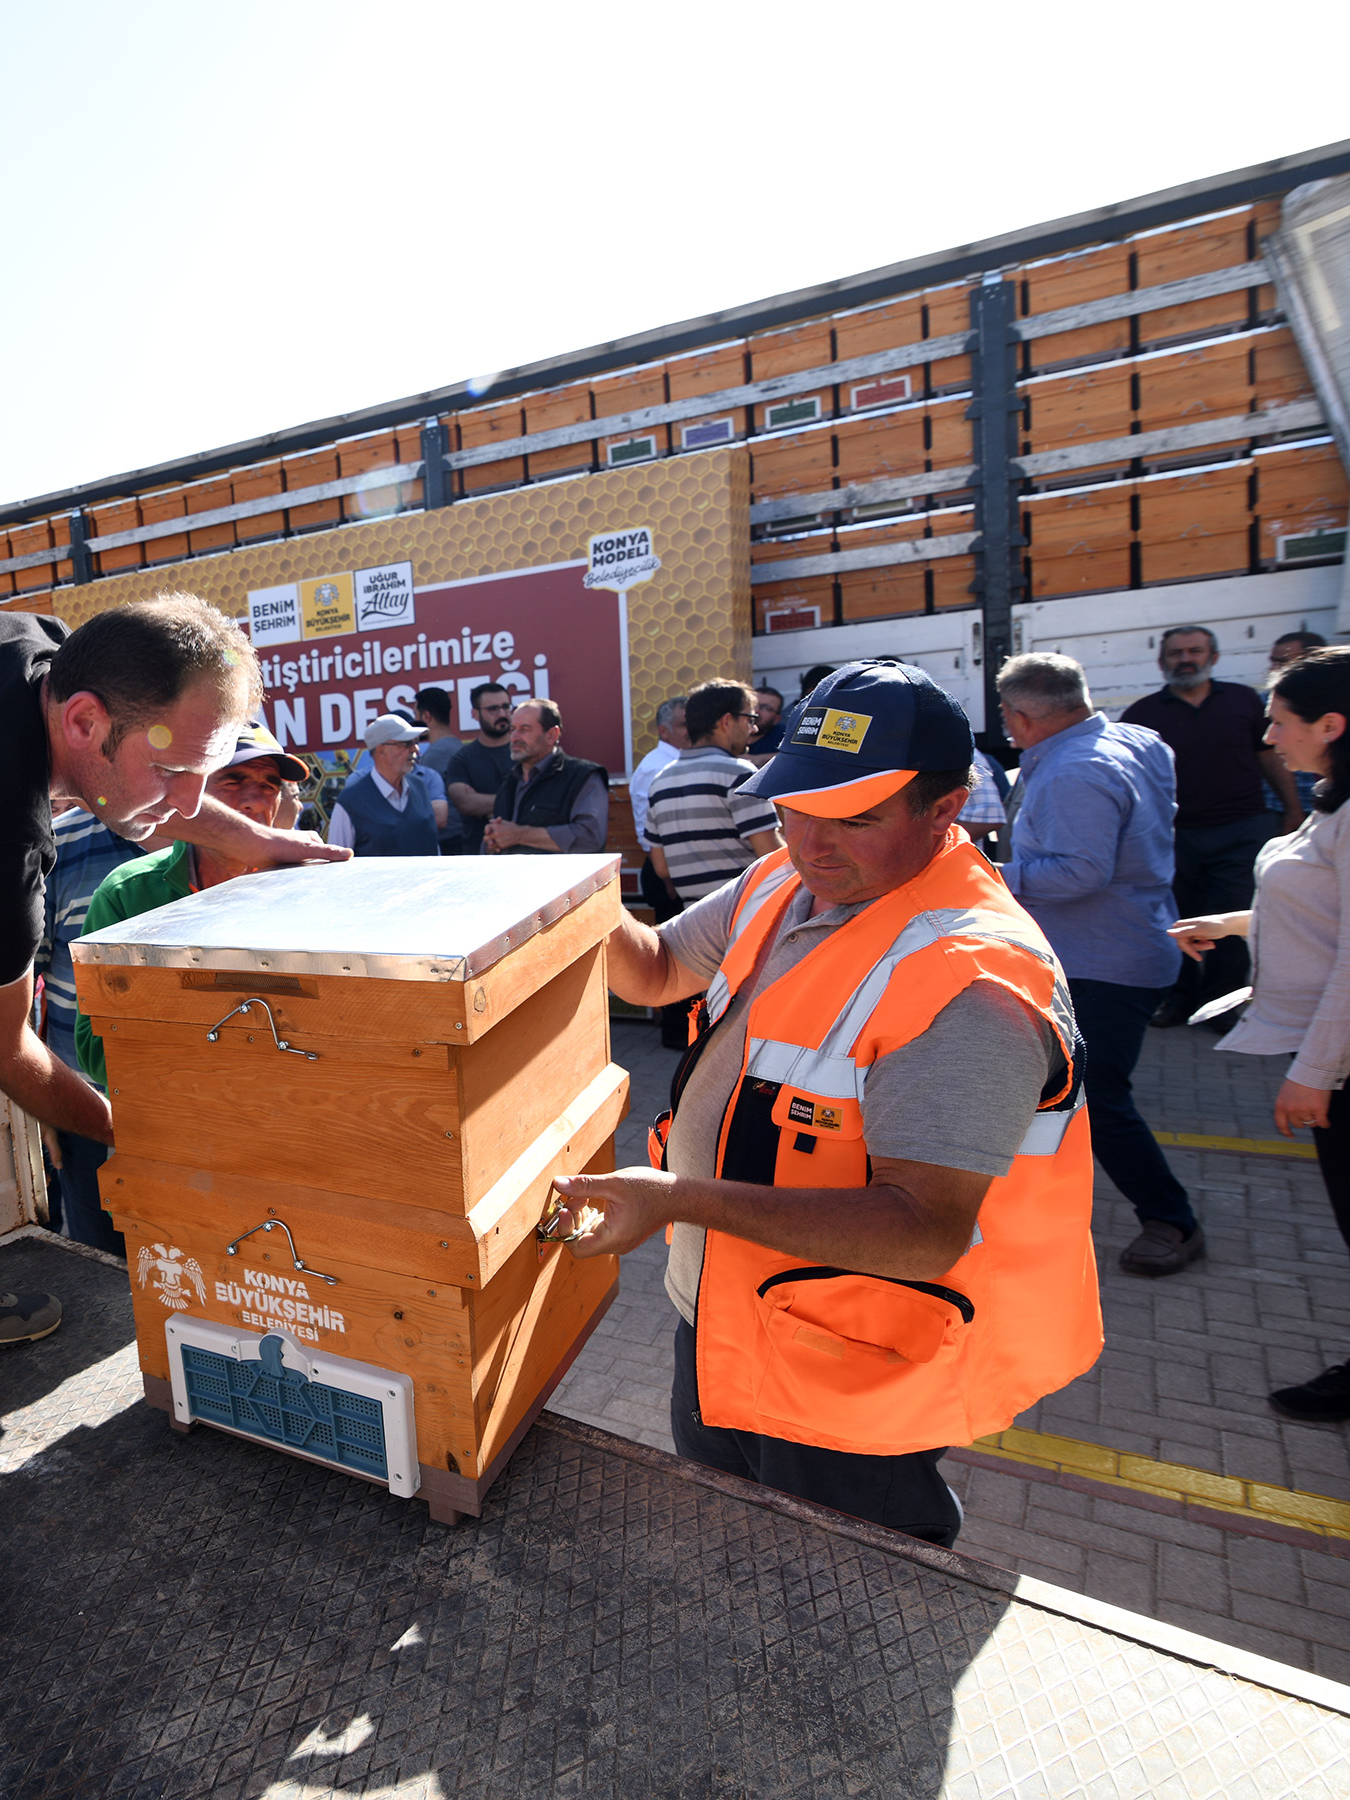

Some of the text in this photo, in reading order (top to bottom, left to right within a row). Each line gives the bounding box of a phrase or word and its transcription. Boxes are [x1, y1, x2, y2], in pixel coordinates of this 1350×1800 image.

[593, 531, 649, 554] KONYA
[592, 545, 649, 567] MODELİ
[369, 571, 398, 584] UĞUR
[585, 557, 659, 587] Belediyecilik
[363, 579, 406, 594] İBRAHİM
[253, 599, 295, 618] BENİM
[361, 592, 409, 620] Altay
[254, 615, 296, 633] ŞEHRİM
[244, 1269, 310, 1300] KONYA
[215, 1281, 346, 1333] BÜYÜKŞEHİR
